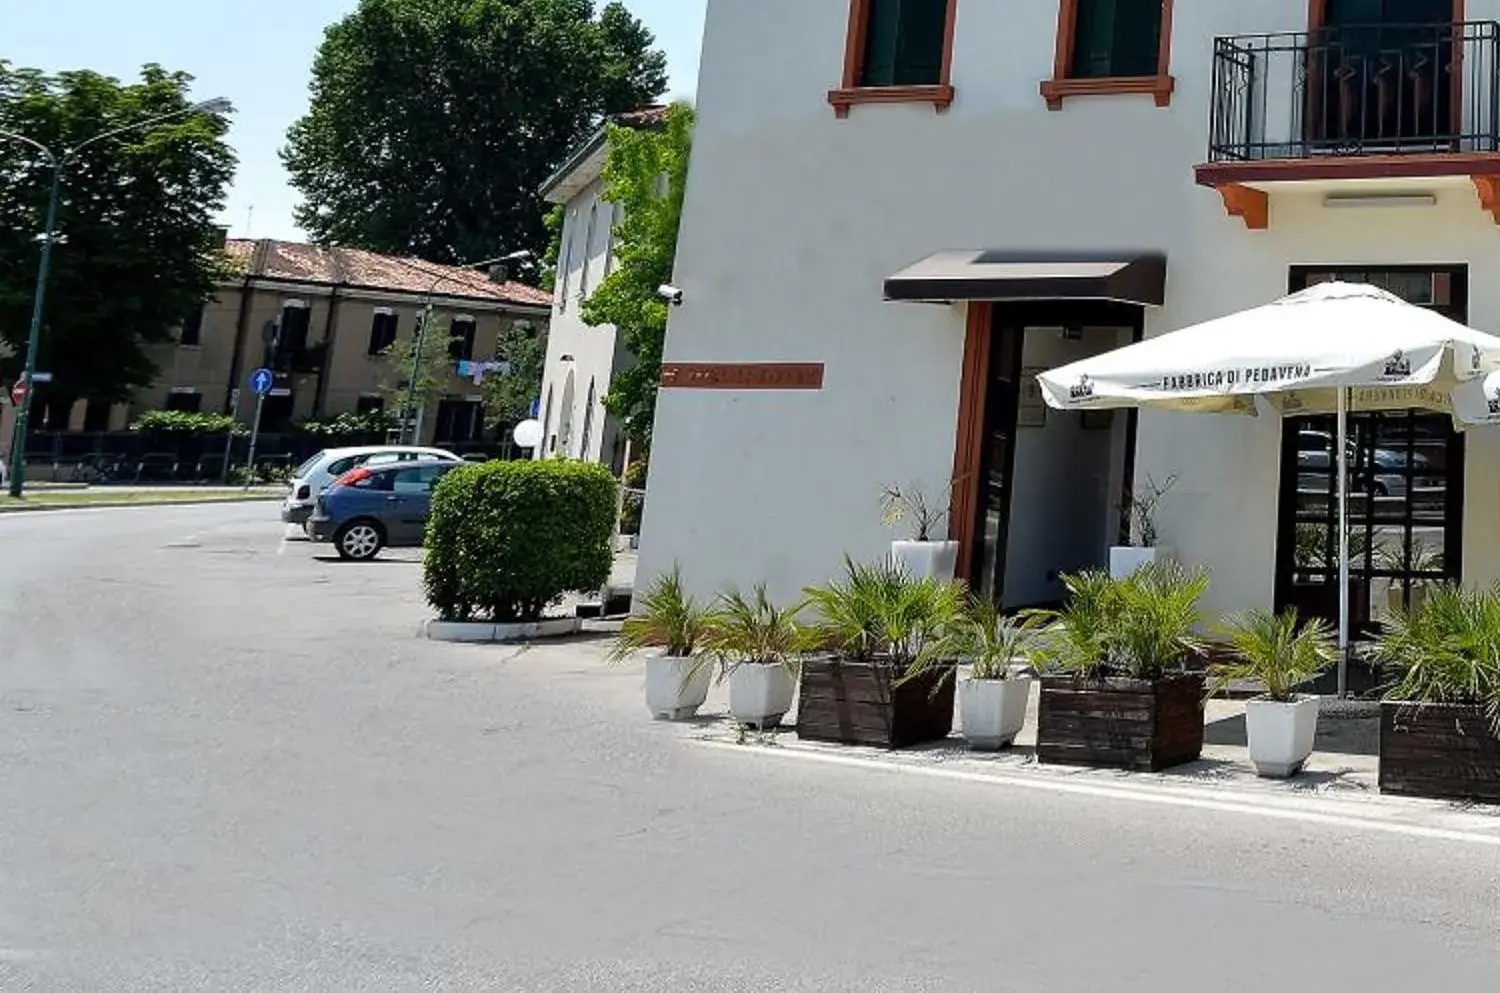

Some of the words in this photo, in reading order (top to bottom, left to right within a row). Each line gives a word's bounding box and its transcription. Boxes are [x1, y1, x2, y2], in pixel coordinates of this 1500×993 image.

[1163, 371, 1223, 391] FABBRICA
[1227, 369, 1240, 384] DI
[1245, 365, 1311, 383] PEDAVENA
